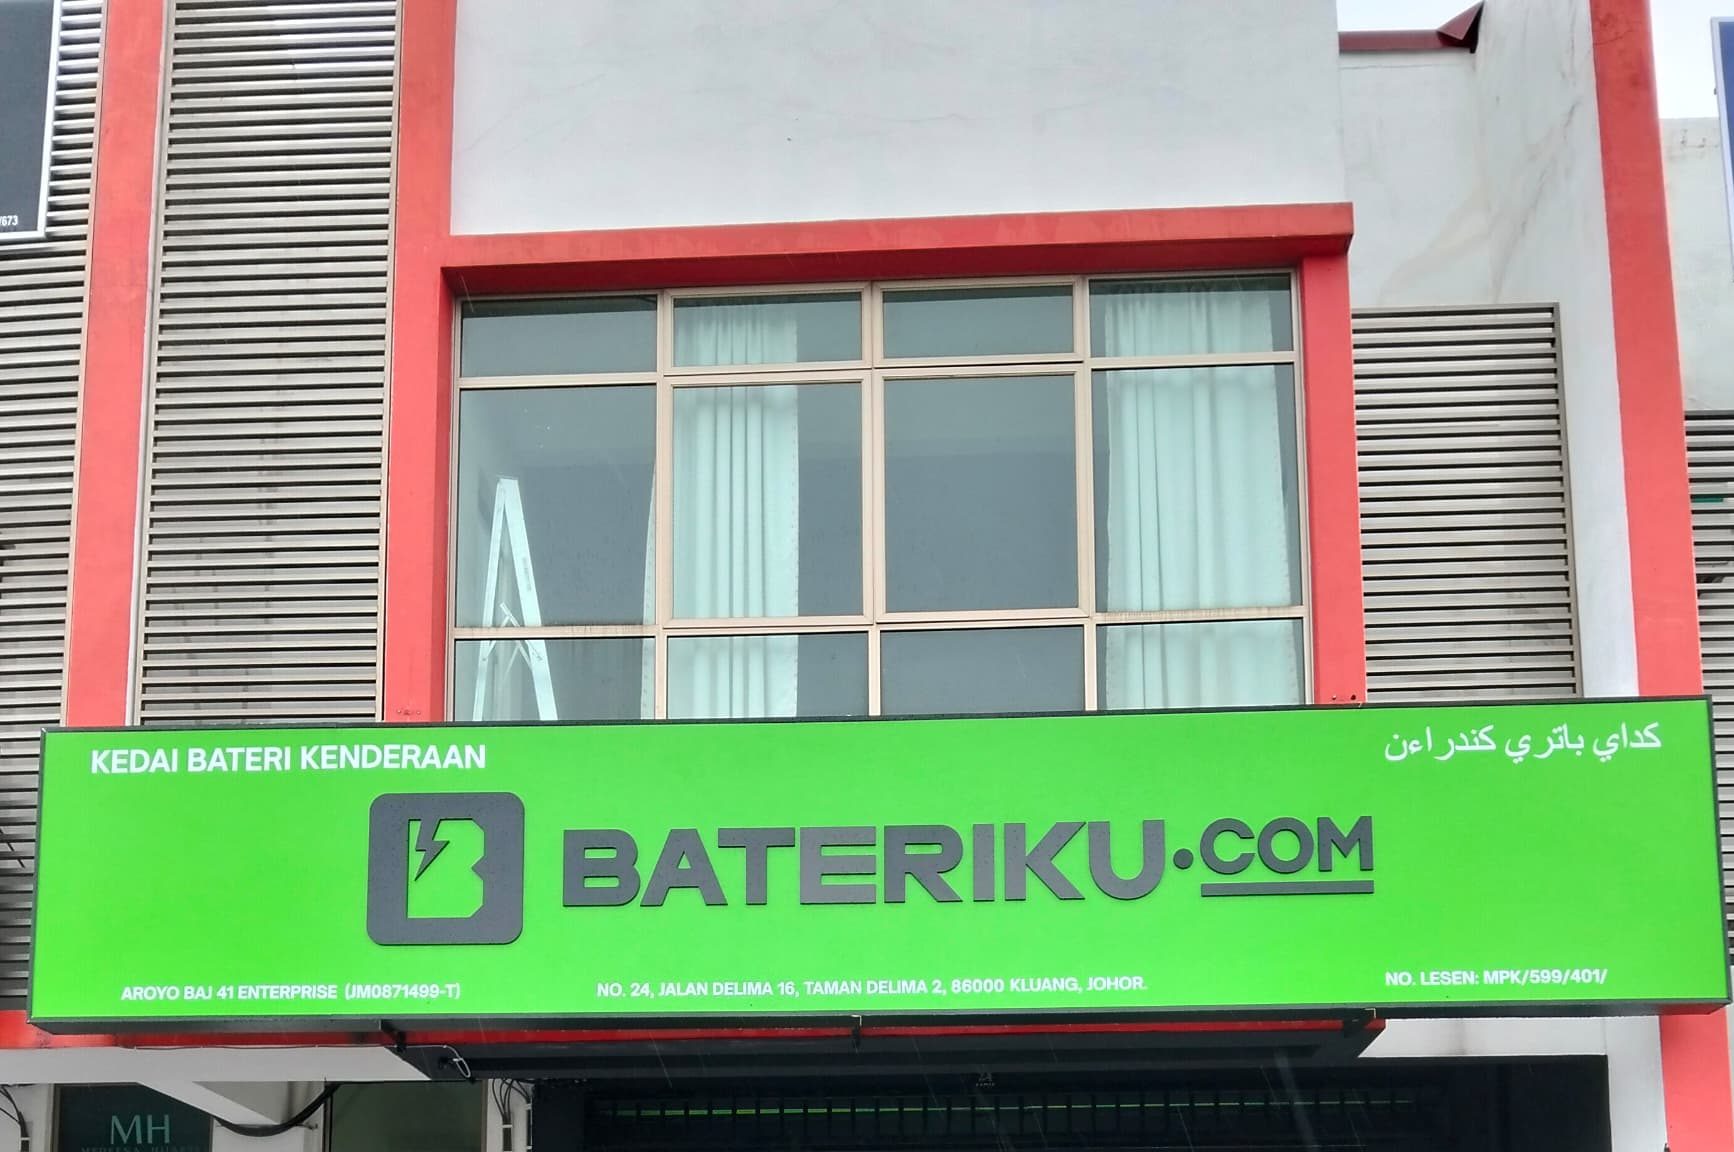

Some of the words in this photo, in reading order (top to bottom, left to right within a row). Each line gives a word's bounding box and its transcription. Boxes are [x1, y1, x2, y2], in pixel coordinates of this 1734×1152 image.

[91, 748, 179, 774] KEDAI
[187, 746, 292, 773] BATERI
[300, 744, 487, 770] KENDERAAN
[596, 982, 626, 998] NO.
[629, 982, 655, 999] 24,
[658, 981, 709, 997] JALAN
[712, 981, 774, 996] DELIMA
[777, 980, 800, 998] 16,
[803, 980, 863, 996] TAMAN
[866, 979, 929, 996] DELIMA
[931, 978, 947, 996] 2,
[950, 977, 1005, 994] 86000
[1009, 976, 1083, 994] KLUANG,
[1086, 975, 1147, 991] JOHOR.
[1384, 971, 1416, 986] NO.
[1420, 970, 1479, 986] LESEN:
[1482, 968, 1608, 986] MPK/599/401/
[120, 985, 180, 1001] AROYO
[183, 985, 213, 1001] BAJ
[216, 985, 234, 1000] 41
[237, 984, 338, 1000] ENTERPRISE
[344, 982, 461, 1001] (JM0871499-T)
[110, 1114, 170, 1145] MH
